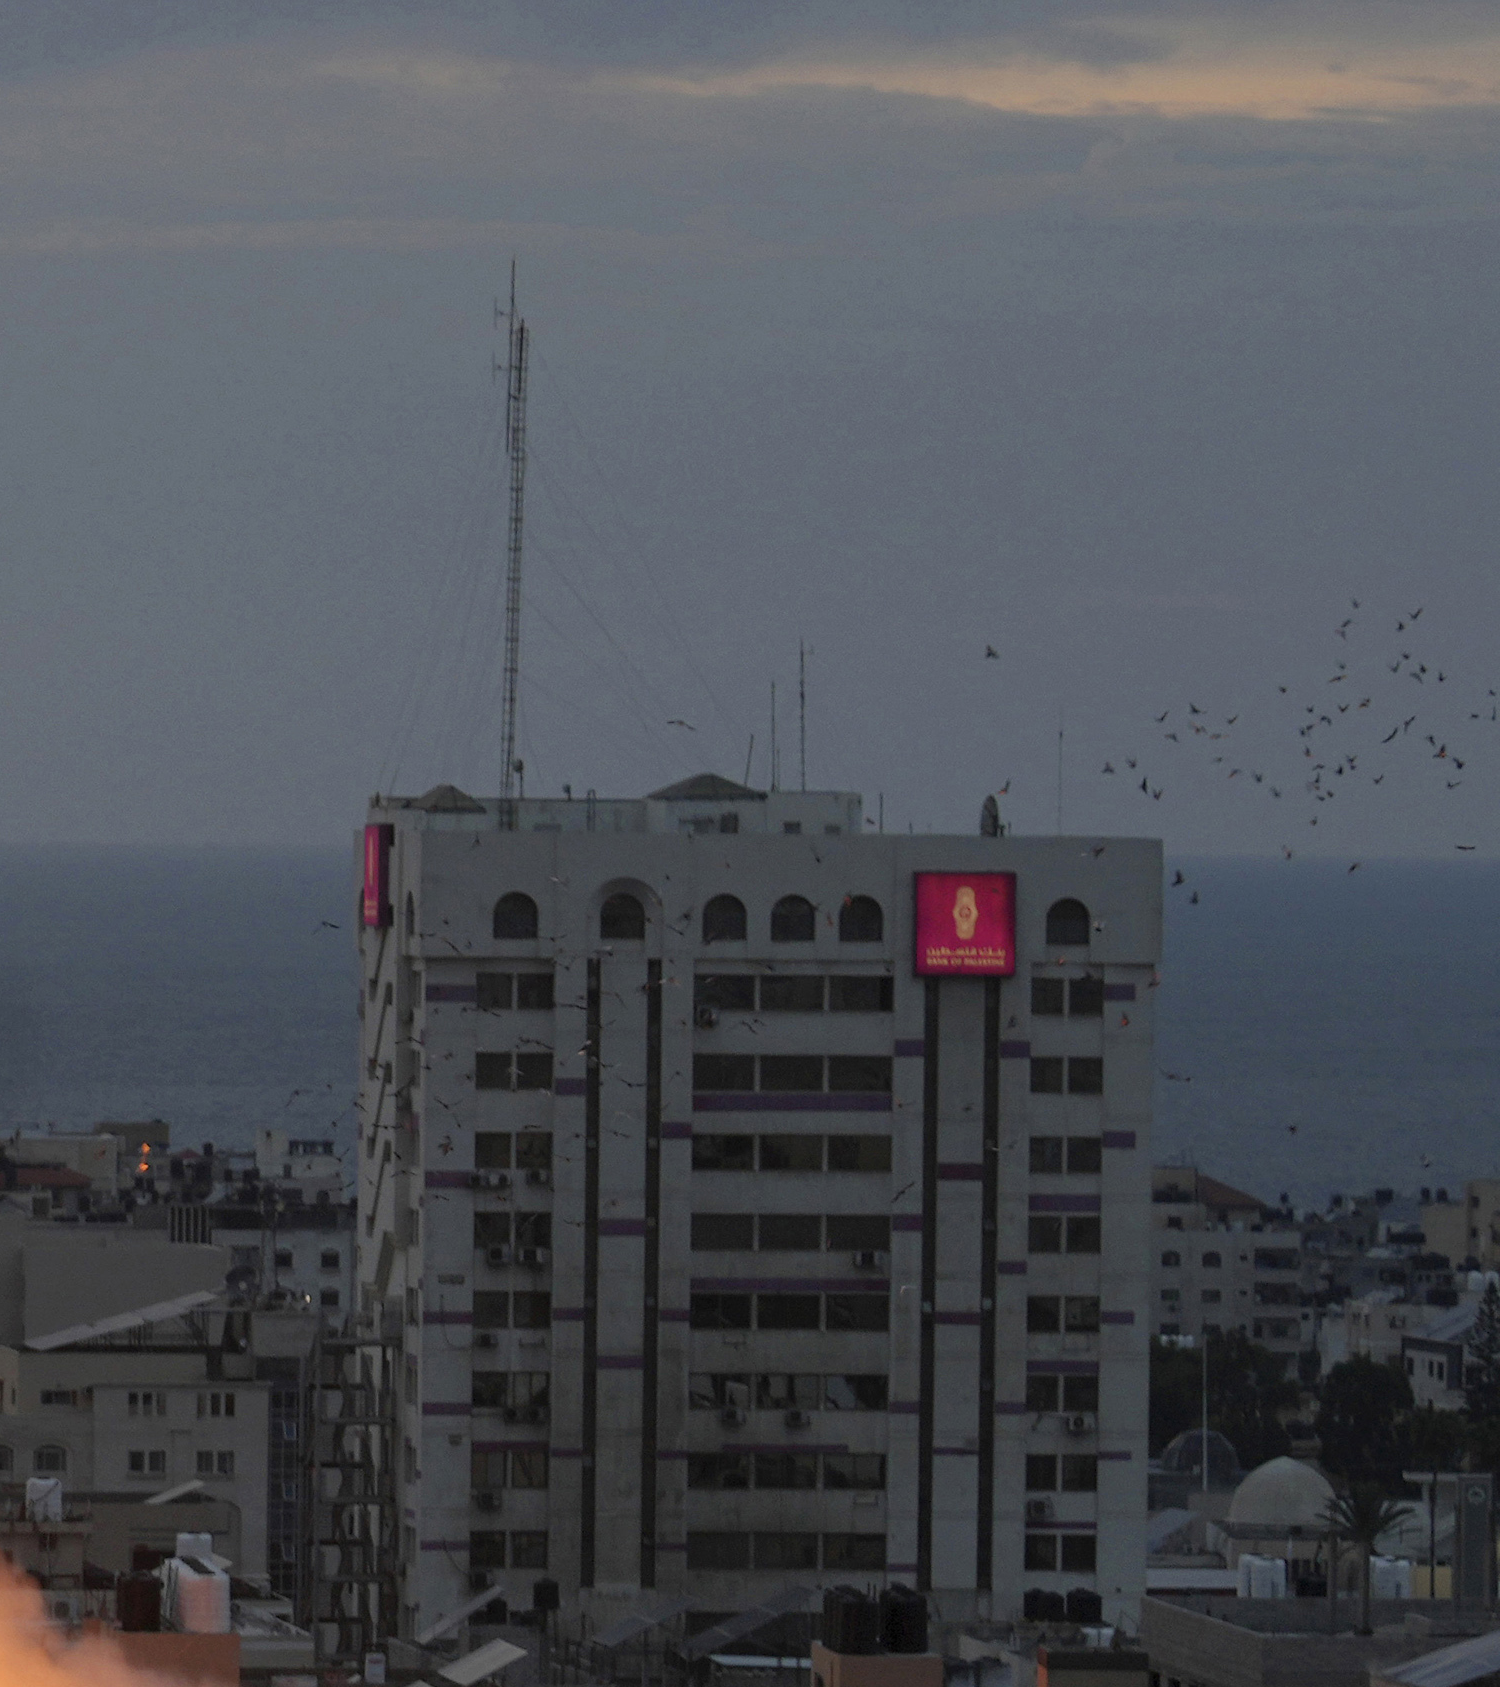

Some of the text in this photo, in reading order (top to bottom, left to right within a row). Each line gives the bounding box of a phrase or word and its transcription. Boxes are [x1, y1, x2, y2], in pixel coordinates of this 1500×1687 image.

[926, 957, 1005, 966] BANK OF PALESTINE
